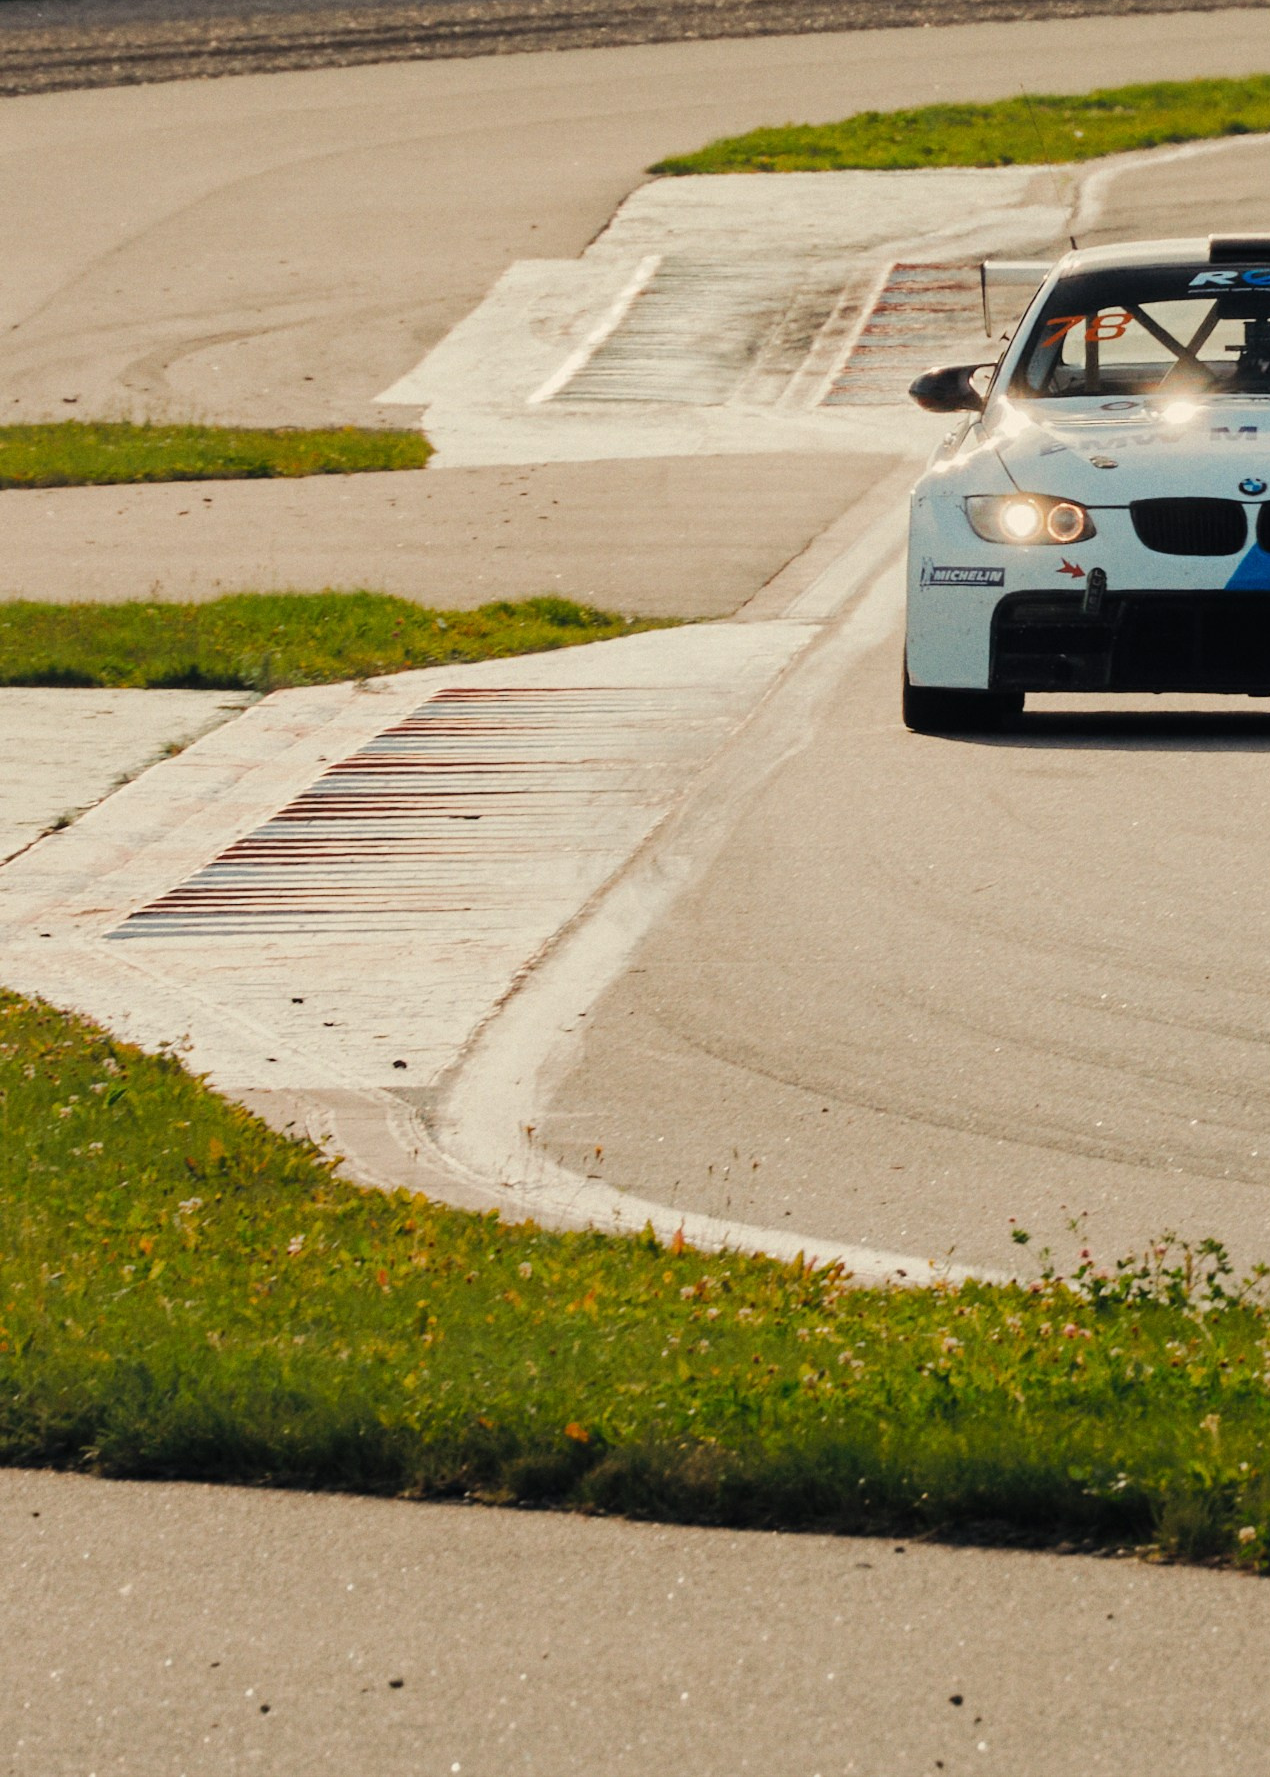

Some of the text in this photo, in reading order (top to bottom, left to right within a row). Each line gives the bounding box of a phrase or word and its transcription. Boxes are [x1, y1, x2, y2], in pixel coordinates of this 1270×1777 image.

[1042, 312, 1134, 348] 78
[1209, 426, 1258, 442] M
[933, 569, 1003, 582] MICHELIN
